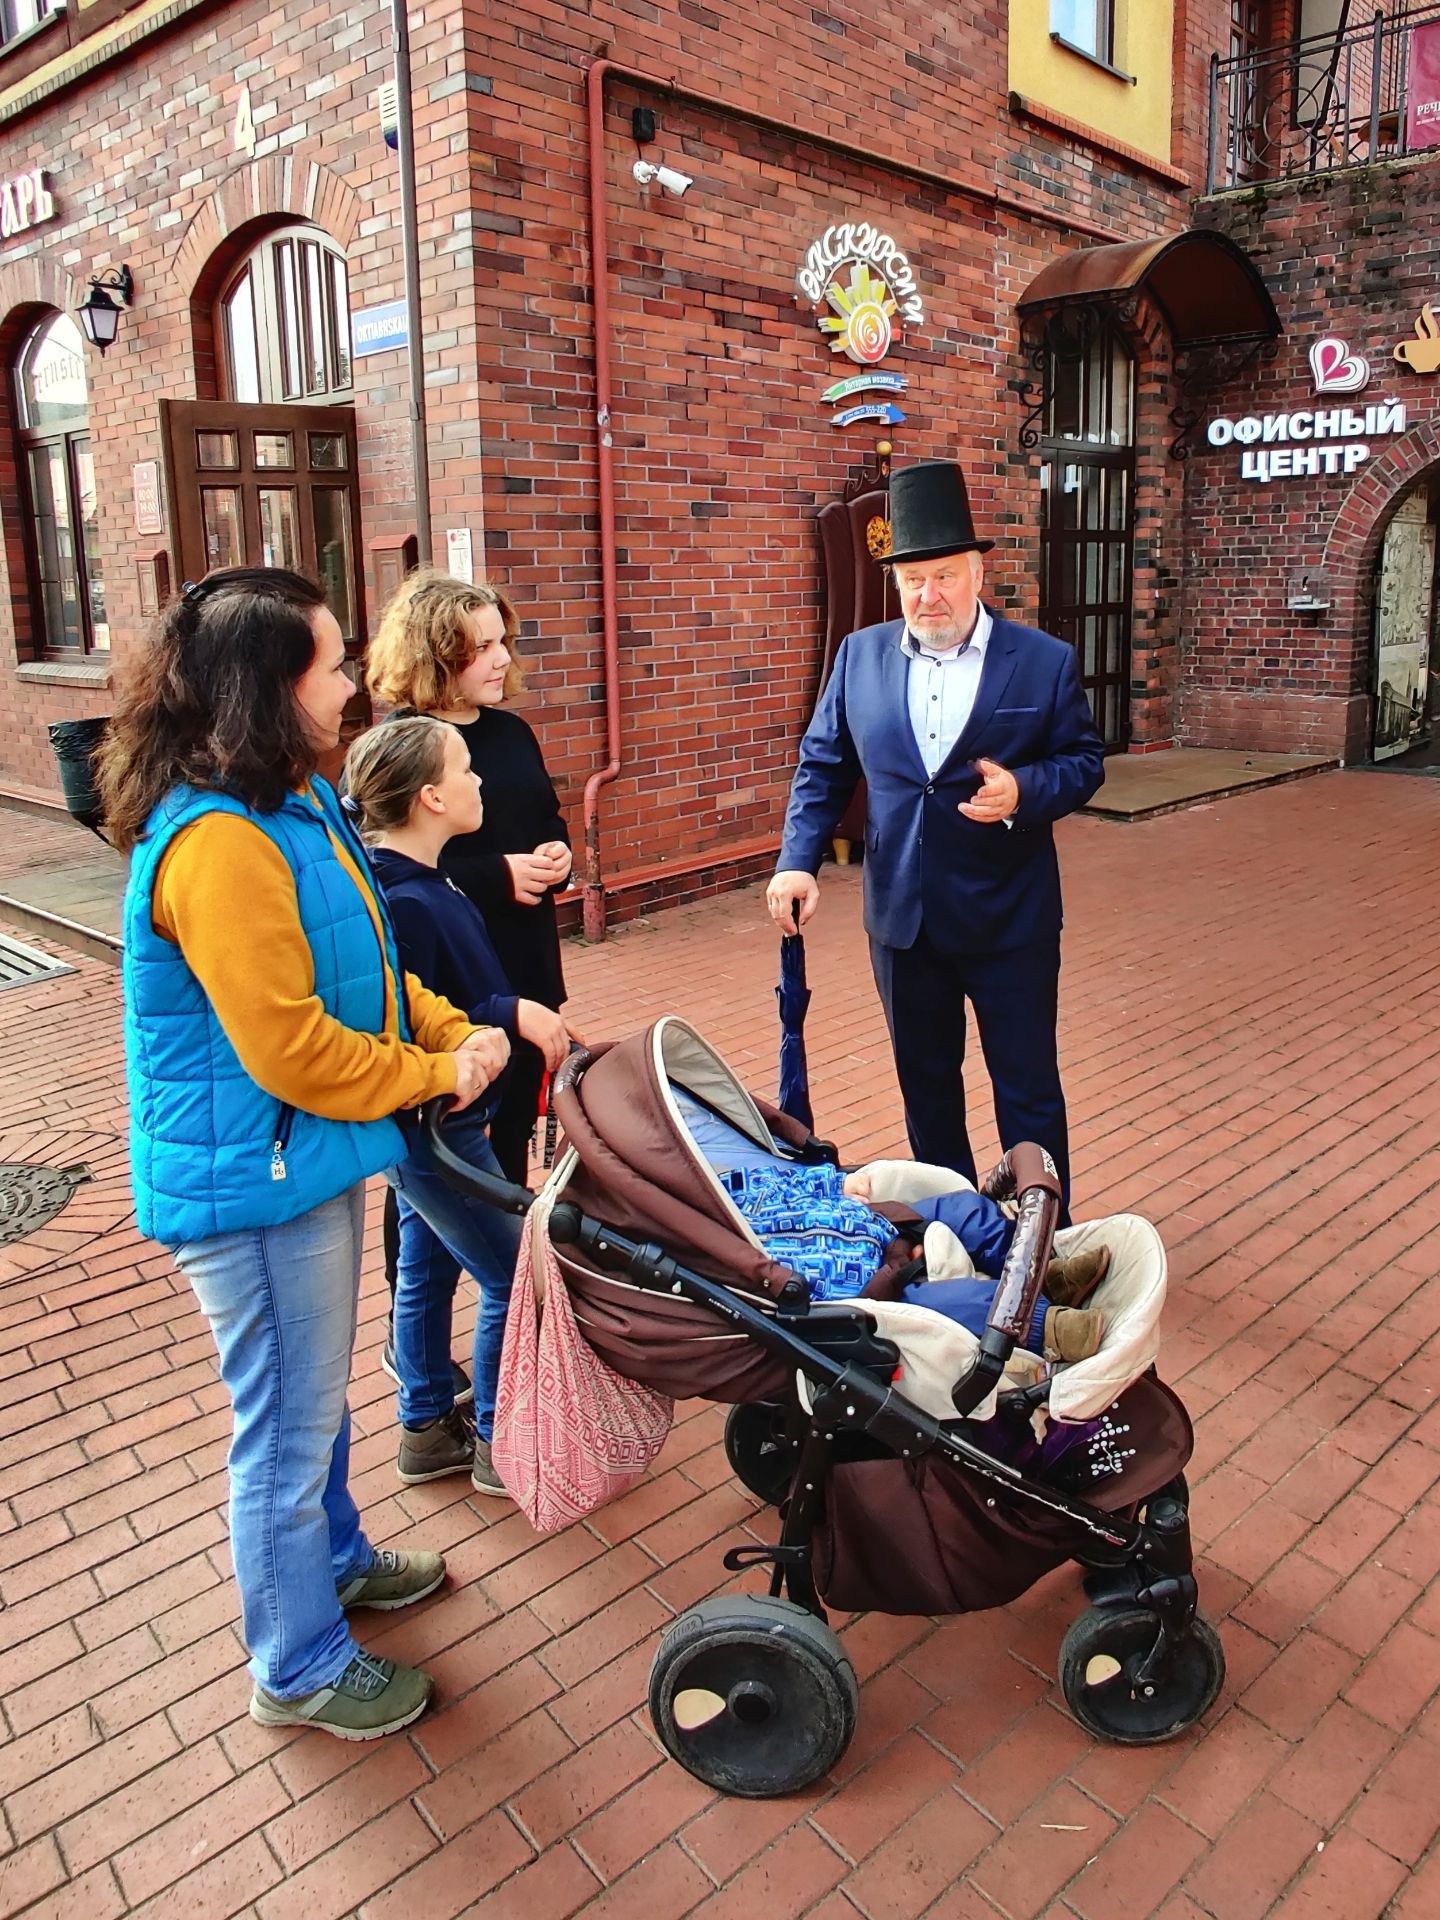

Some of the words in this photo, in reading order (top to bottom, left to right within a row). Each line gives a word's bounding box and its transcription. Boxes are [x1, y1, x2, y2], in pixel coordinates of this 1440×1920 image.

[234, 88, 257, 158] 4
[1416, 100, 1440, 116] РЕЧ
[0, 168, 55, 238] АРЬ
[357, 314, 408, 344] OKTIABRSKAI
[1208, 397, 1406, 446] ОФИСНЫЙ
[1242, 444, 1370, 482] ЦЕНТР
